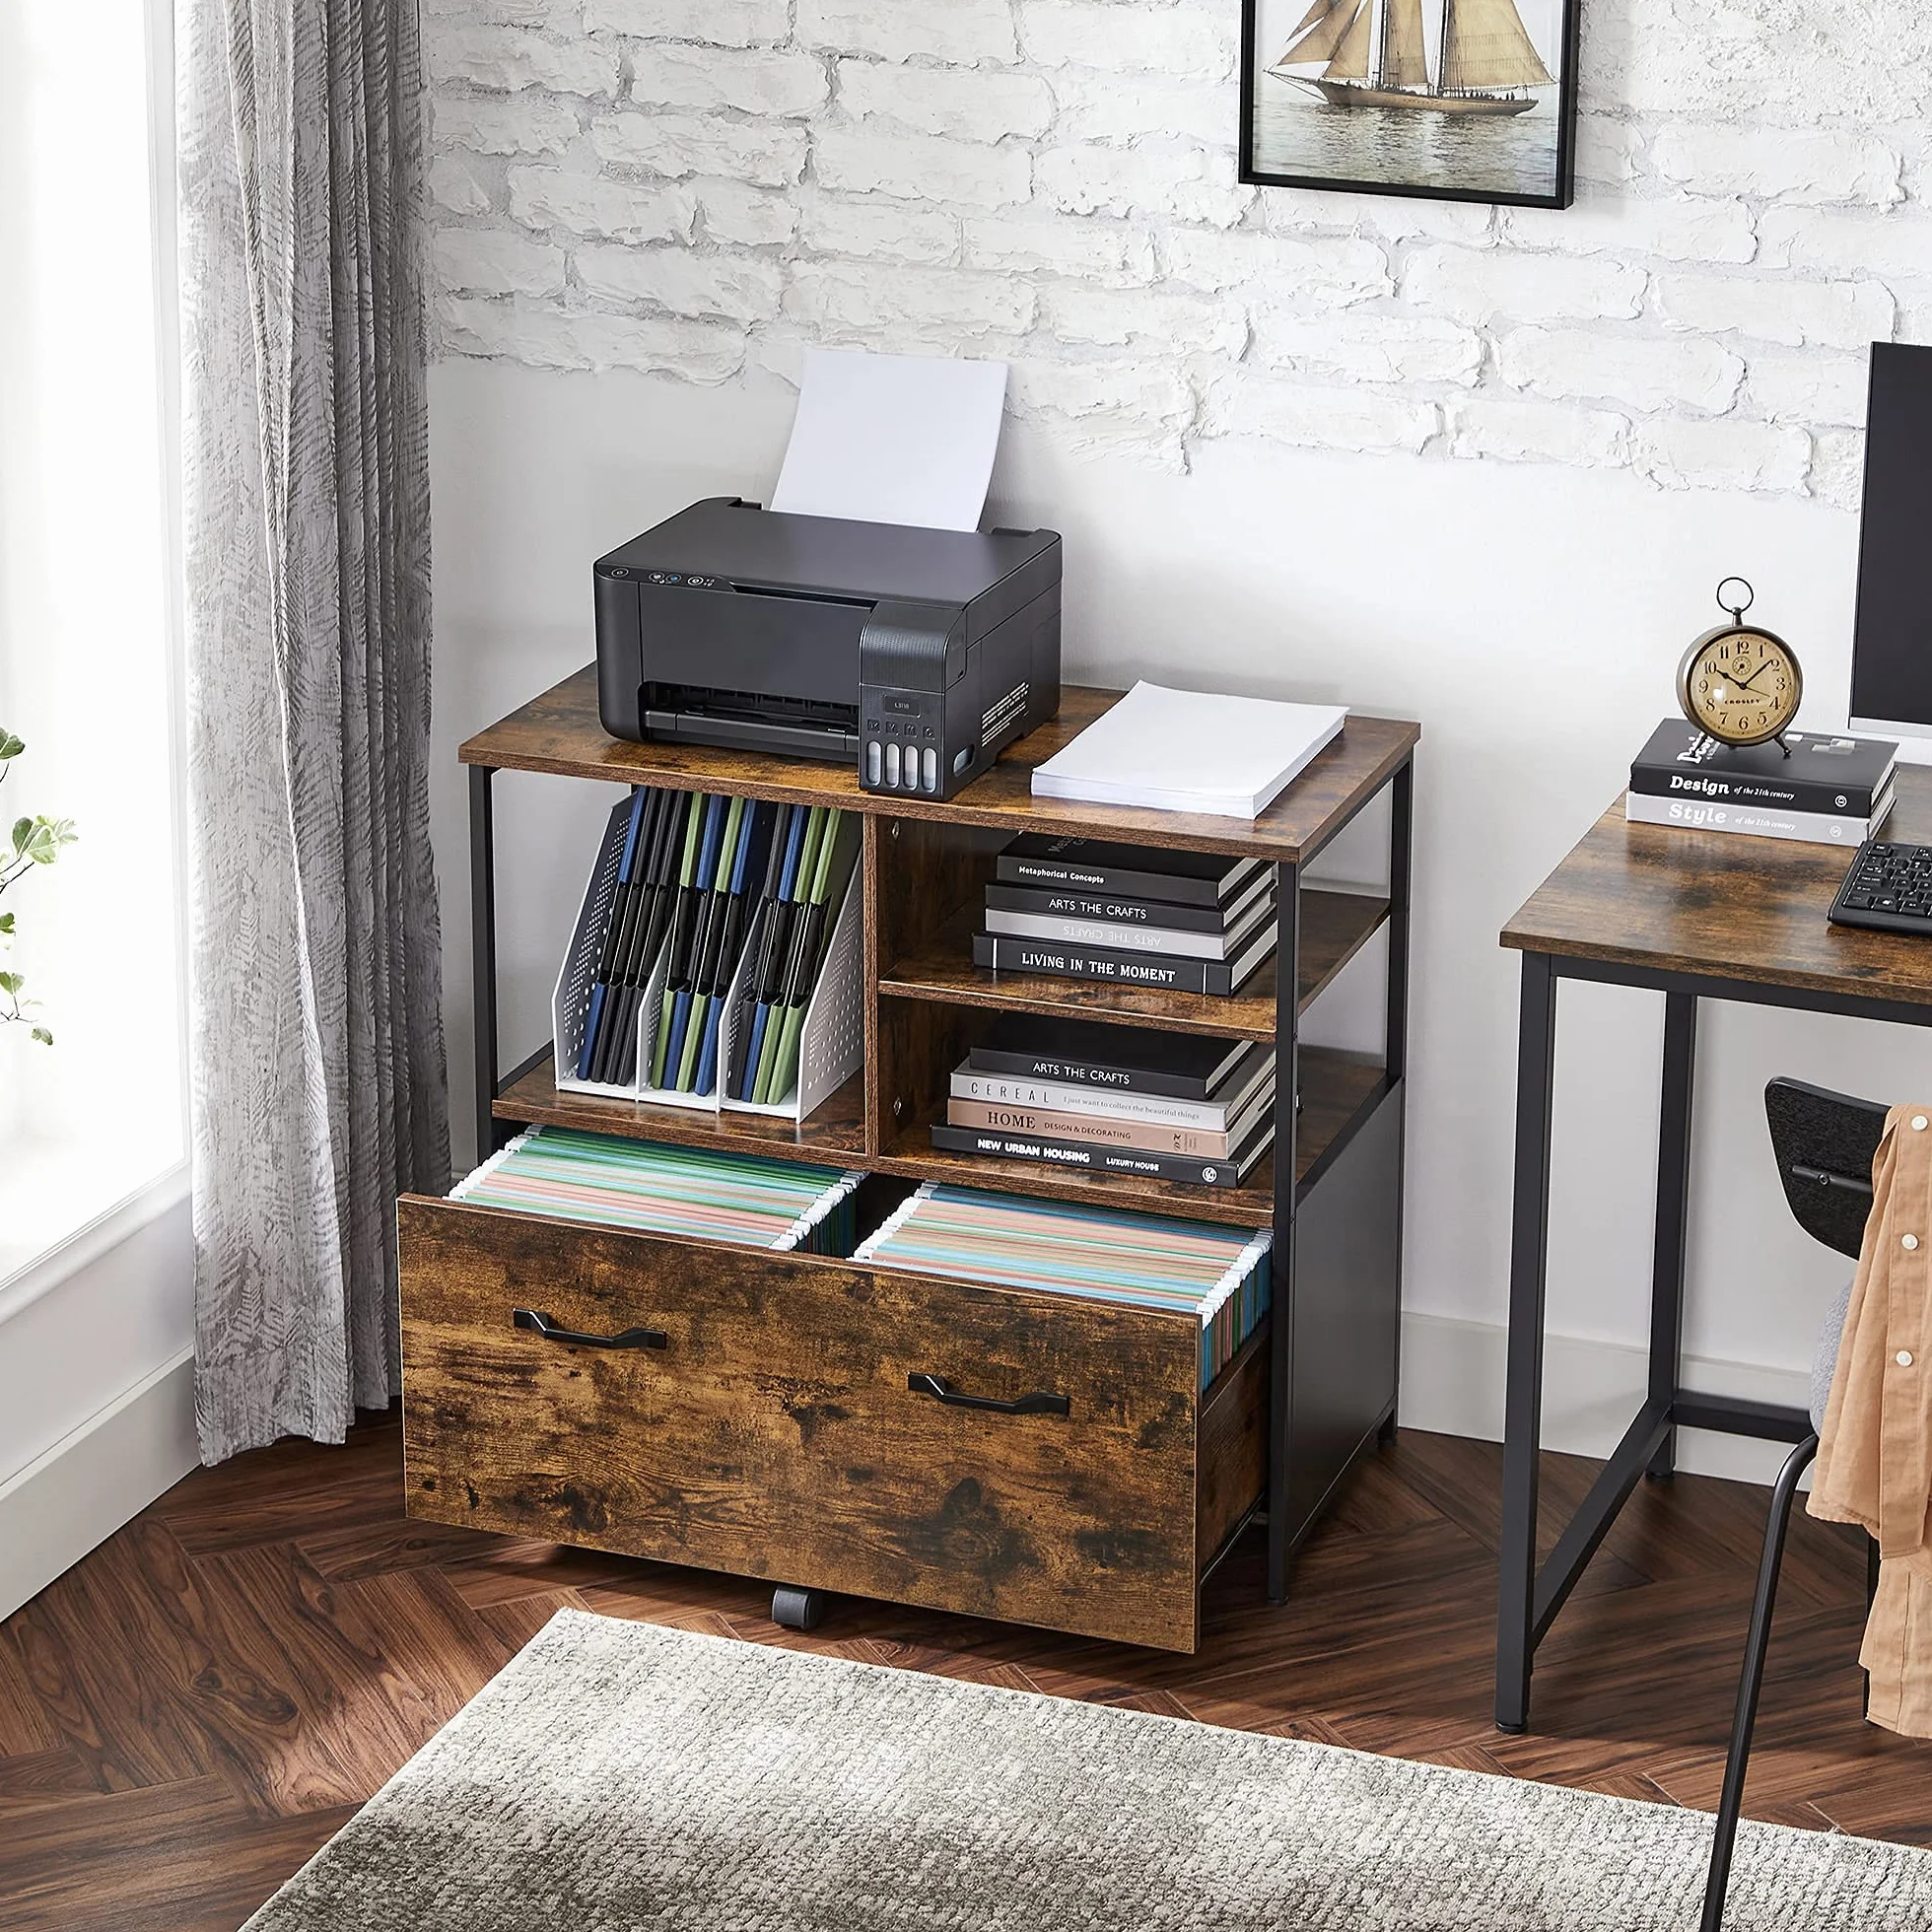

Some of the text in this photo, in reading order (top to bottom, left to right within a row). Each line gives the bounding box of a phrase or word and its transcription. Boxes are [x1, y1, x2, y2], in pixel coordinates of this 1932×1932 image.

[1720, 646, 1729, 658] 11
[1737, 641, 1750, 655] 12
[1760, 645, 1763, 657] 1
[1704, 660, 1716, 674] 10
[1770, 658, 1780, 671] 2
[1698, 679, 1708, 693] 9
[1776, 677, 1785, 690] 3
[1705, 697, 1715, 712] 8
[1768, 696, 1781, 710] 4
[1719, 712, 1729, 724] 7
[1738, 716, 1749, 730] 6
[1757, 711, 1767, 724] 5
[1669, 775, 1730, 795] Design
[1734, 786, 1743, 795] of
[1743, 787, 1755, 795] the
[1769, 790, 1795, 800] century
[1668, 802, 1727, 825] Style
[1735, 816, 1745, 825] of
[1770, 820, 1796, 832] century
[1018, 866, 1104, 884] Metaphorical Concepts
[1049, 898, 1147, 920] ARTS THE CRAFTS
[1063, 926, 1162, 946] ARTS THE CRAFTS
[1021, 952, 1176, 983] LIVING IN THE MOMENT
[1033, 1062, 1131, 1085] ARTS THE CRAFTS
[971, 1081, 1050, 1103] CEREAL
[1109, 1102, 1132, 1111] collect
[1132, 1104, 1144, 1113] the
[1144, 1106, 1177, 1117] beautiful
[1177, 1111, 1200, 1121] things
[987, 1111, 1037, 1130] HOME
[1044, 1122, 1072, 1133] DESIGN
[1081, 1127, 1132, 1139] DECORATING
[977, 1138, 1160, 1172] NEW URBAN HOUSING LUXURY HOUSE
